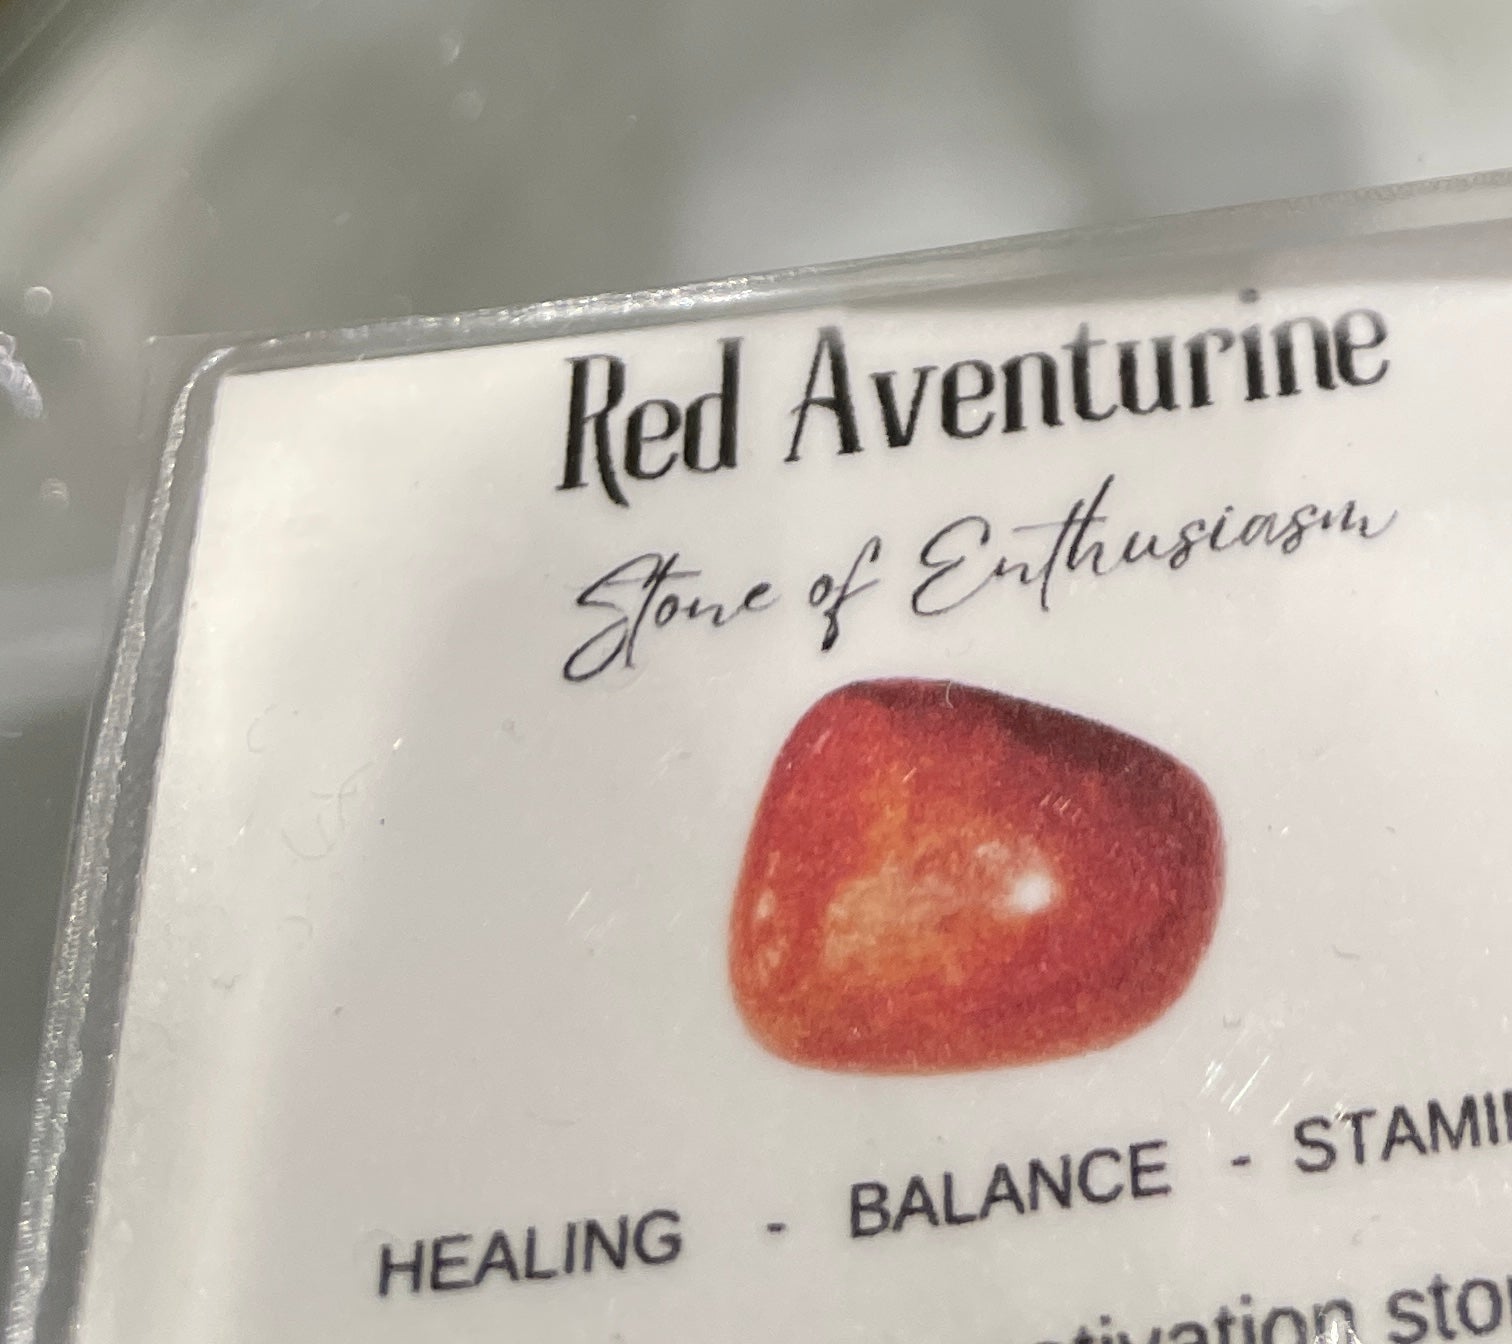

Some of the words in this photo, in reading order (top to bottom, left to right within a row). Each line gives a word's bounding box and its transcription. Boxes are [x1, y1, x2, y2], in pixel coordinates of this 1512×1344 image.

[554, 339, 742, 510] Red
[782, 286, 1391, 464] Aventurine
[560, 551, 778, 684] Stone
[807, 535, 880, 653] of
[909, 472, 1396, 620] Enthusiasm
[375, 1208, 685, 1298] HEALING
[847, 1140, 1174, 1240] BALANCE
